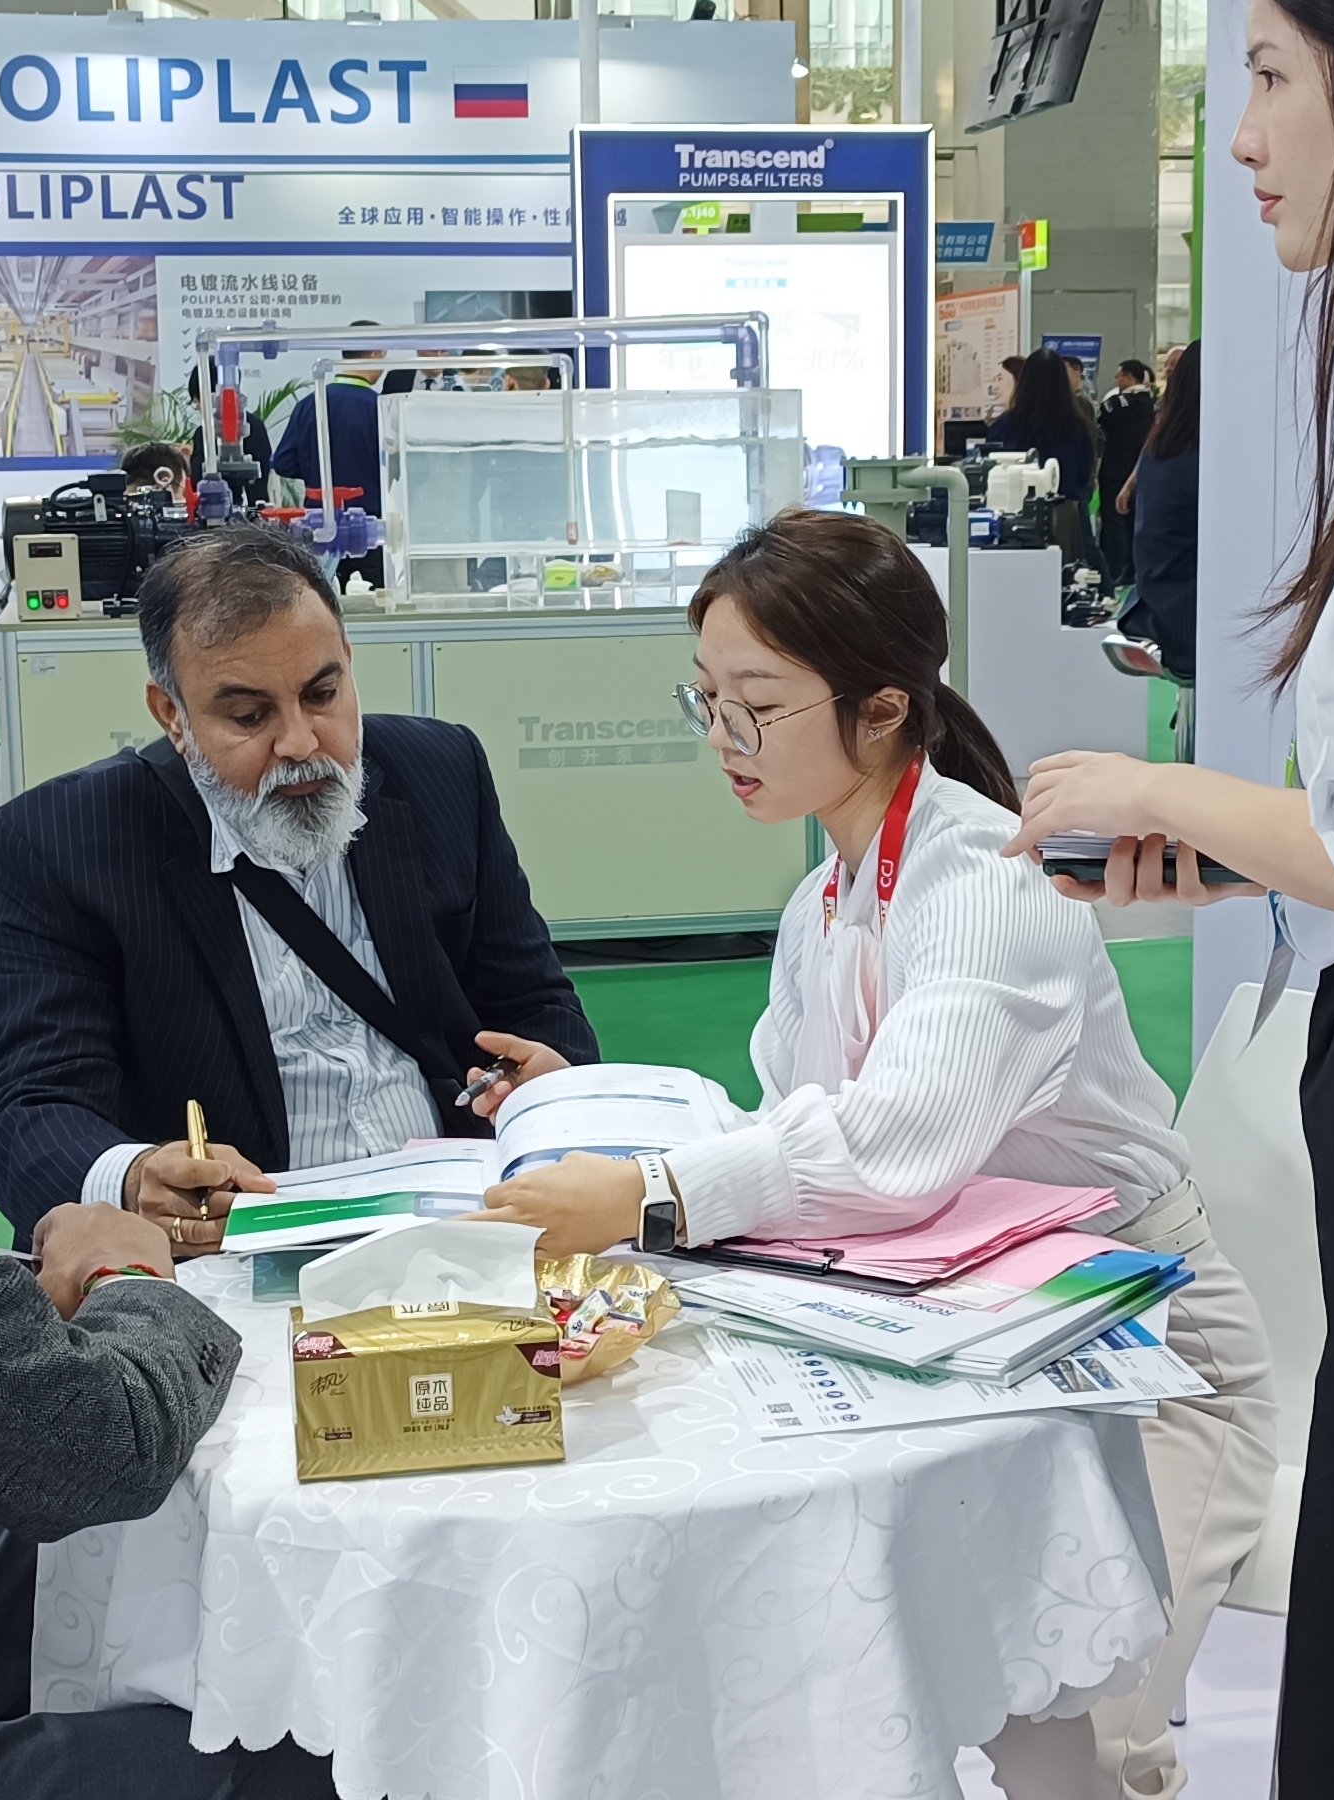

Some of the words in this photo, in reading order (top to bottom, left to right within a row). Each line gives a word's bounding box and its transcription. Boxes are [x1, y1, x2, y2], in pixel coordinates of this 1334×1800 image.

[674, 142, 827, 169] Transcend
[678, 172, 824, 188] PUMPS&FILTERS
[181, 273, 319, 292] 电镀流水线设备
[181, 294, 246, 305] POLIPLAST
[547, 746, 667, 768] 创升泵业
